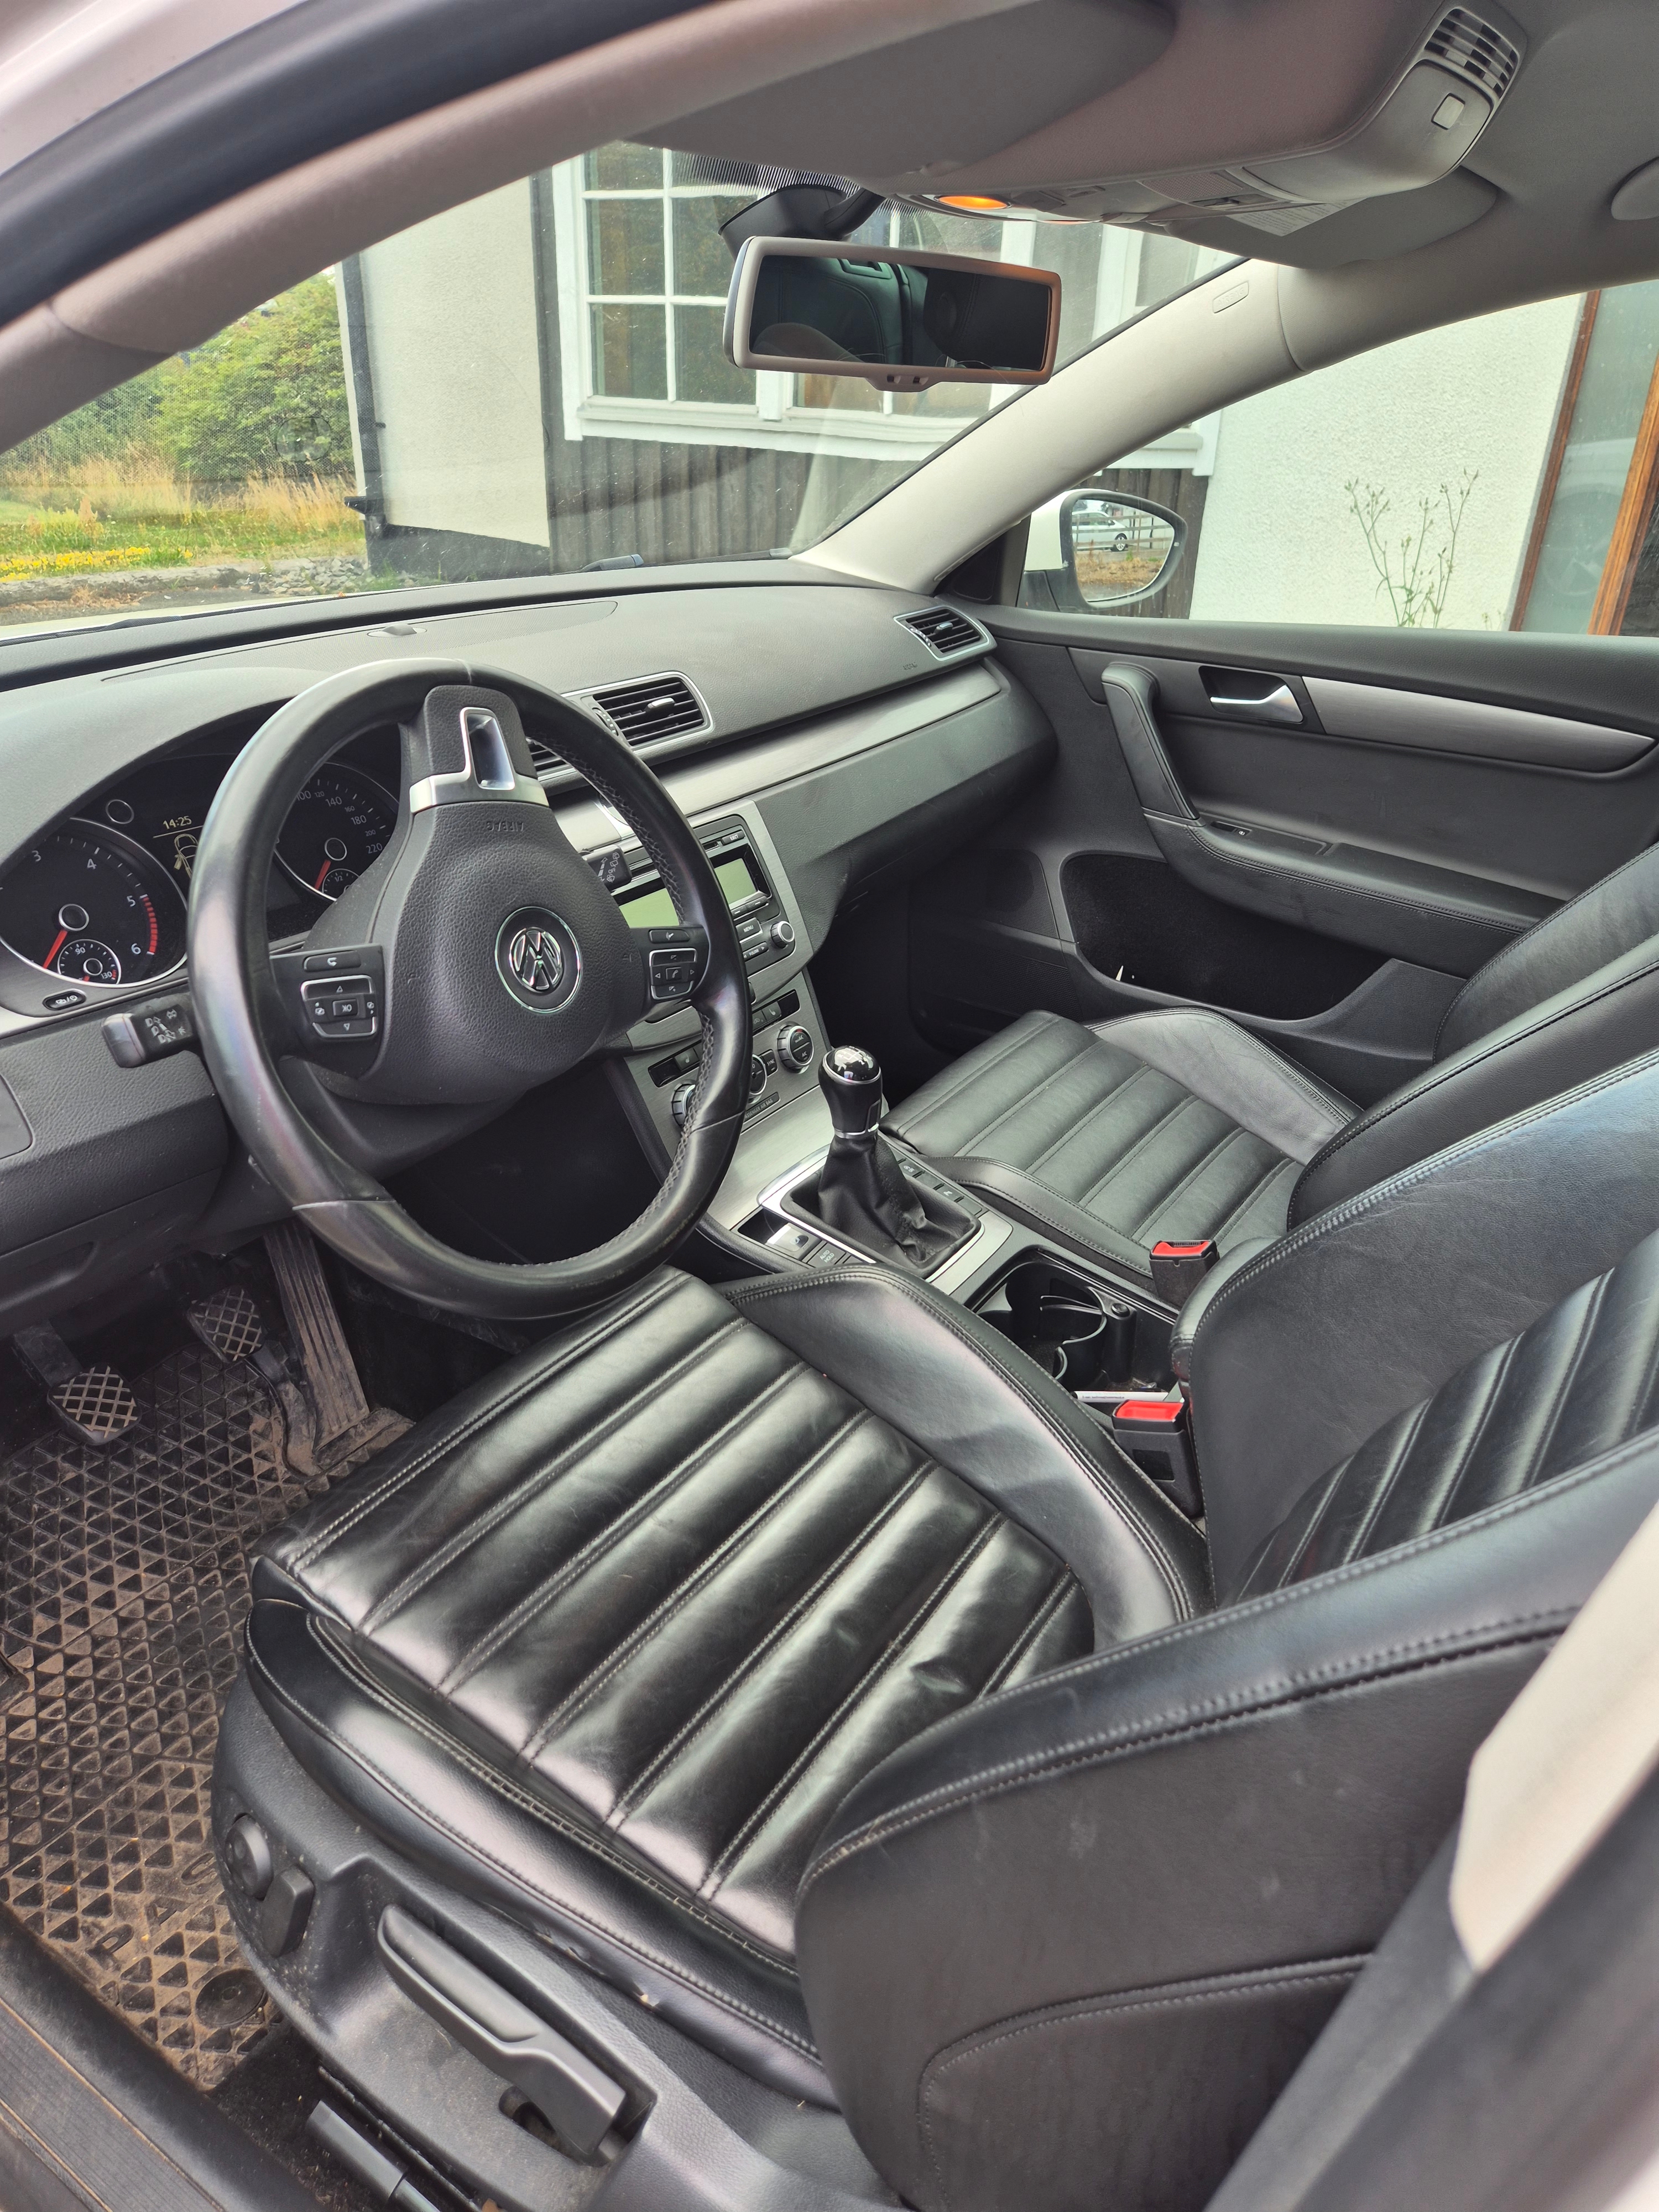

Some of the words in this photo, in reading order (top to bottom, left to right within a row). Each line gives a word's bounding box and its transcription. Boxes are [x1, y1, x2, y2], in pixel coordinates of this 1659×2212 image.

[326, 796, 342, 807] 140
[163, 816, 192, 829] 14:25
[351, 815, 367, 825] 180
[487, 821, 524, 832] AIRBAG
[366, 843, 383, 854] 220
[32, 850, 42, 862] 3
[87, 858, 97, 870] 4
[127, 895, 136, 907] 5
[743, 925, 754, 933] MENU
[75, 947, 86, 955] 90
[131, 943, 142, 955] 6
[100, 971, 112, 979] 130
[745, 1106, 760, 1119] ASSENGER
